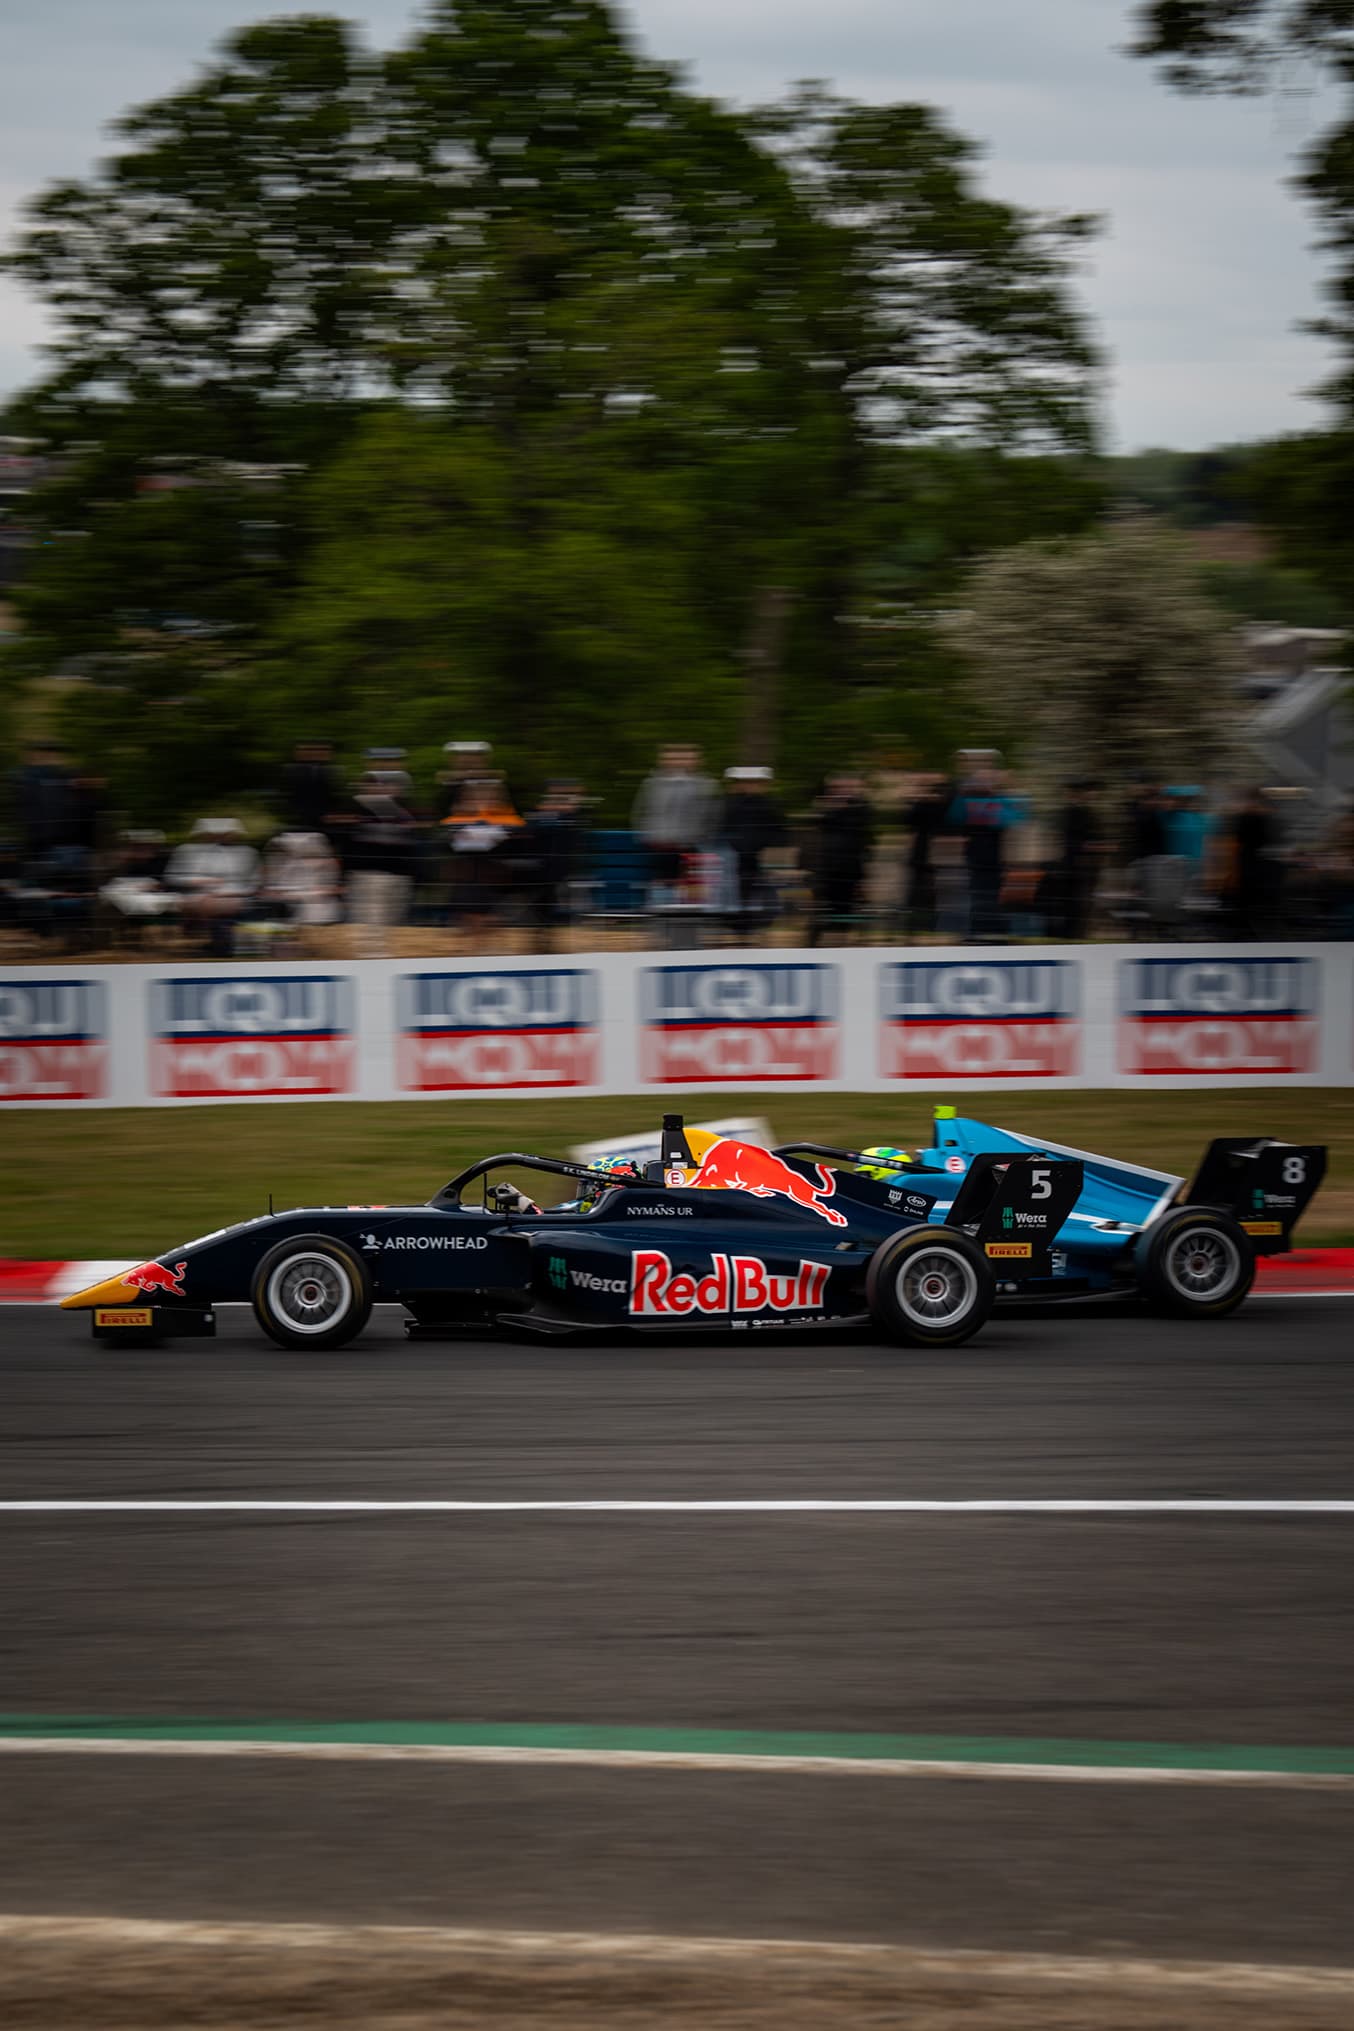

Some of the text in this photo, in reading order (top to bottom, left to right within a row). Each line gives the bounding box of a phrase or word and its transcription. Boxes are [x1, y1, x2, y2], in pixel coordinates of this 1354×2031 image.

[1283, 1157, 1305, 1183] 8
[1031, 1170, 1052, 1199] 5
[677, 1207, 693, 1216] UR
[1015, 1213, 1047, 1224] Wera
[384, 1237, 488, 1250] ARROWHEAD
[570, 1271, 627, 1294] Wera
[629, 1250, 832, 1316] Red Bull
